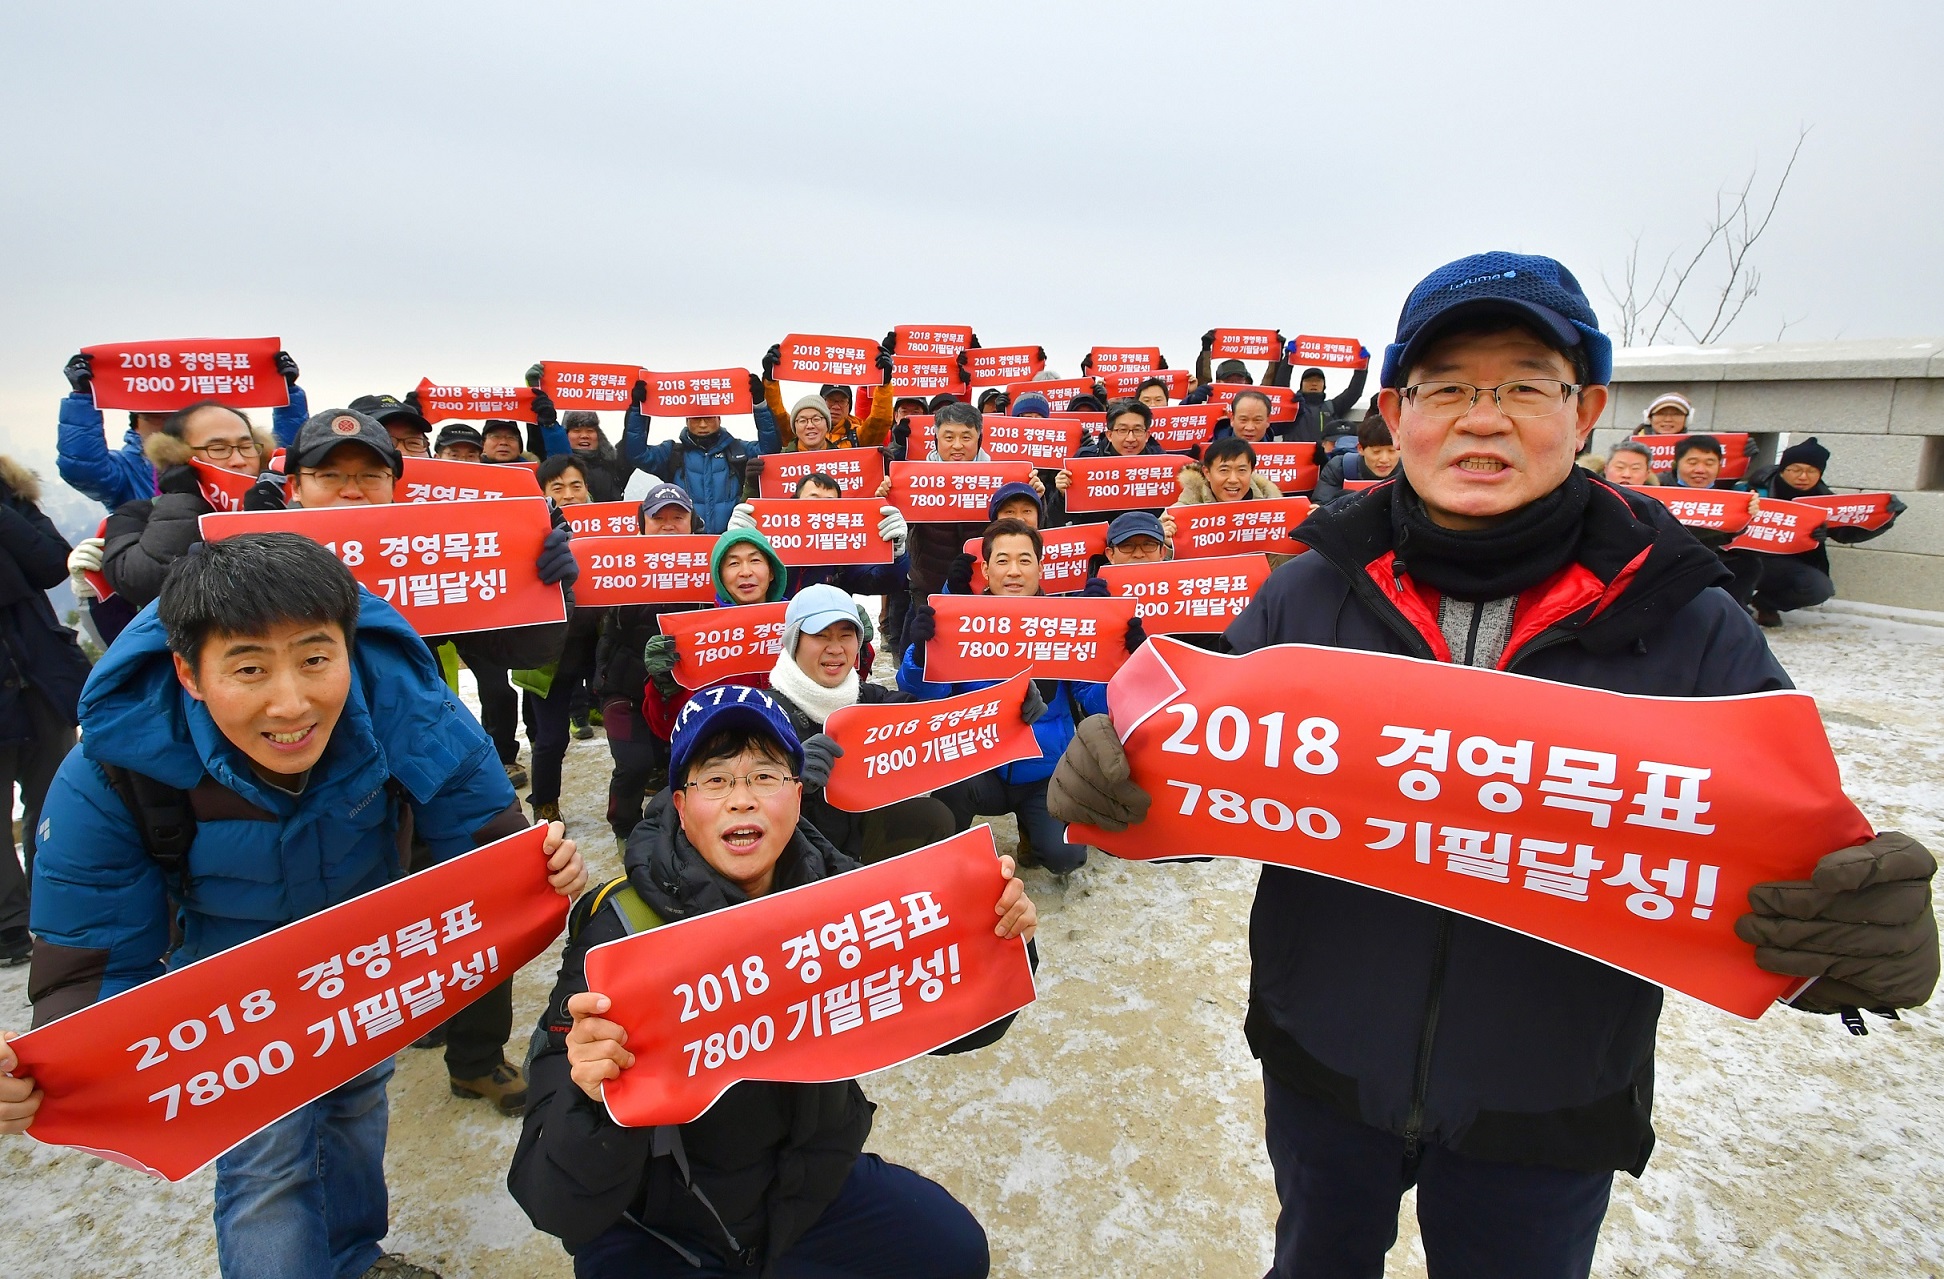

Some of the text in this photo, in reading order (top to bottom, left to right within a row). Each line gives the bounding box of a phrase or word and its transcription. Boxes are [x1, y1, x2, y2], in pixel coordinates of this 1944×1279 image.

[793, 345, 865, 360] 2018 경영목표
[1301, 342, 1352, 353] 2018 경영목표
[120, 353, 250, 371] 2018 경영목표
[975, 355, 1029, 365] 2018 경영목표
[1322, 353, 1354, 362] 기필달성!
[793, 360, 866, 375] 7800 기필달성!
[891, 364, 947, 374] 018 경영목표
[975, 366, 1030, 377] 7800 기필달성!
[123, 376, 254, 393] 7800 기필달성!
[558, 373, 626, 386] 2018 경영목표
[657, 379, 731, 390] 2018 경영목표
[891, 376, 948, 387] 800 기필달성!
[1118, 377, 1139, 385] 2018
[428, 387, 461, 397] 2018
[557, 388, 627, 401] 7800 기필달성!
[659, 393, 733, 405] 7800 기필달성!
[431, 401, 463, 410] 7800
[1171, 416, 1206, 428] 경영목표
[923, 426, 937, 437] 20
[991, 427, 1066, 442] 2018 경영목표
[1167, 429, 1206, 441] 기필달성!
[990, 443, 1067, 460] 7800 기필달성!
[780, 461, 861, 477] 2018 경영목표
[1088, 467, 1173, 480] 2018 경영목표
[781, 483, 797, 494] 78
[910, 475, 1003, 490] 2018 경영목표
[1088, 482, 1174, 496] 7800 기필달성!
[209, 484, 240, 512] 201
[910, 495, 945, 506] 7800
[1669, 501, 1724, 516] 경영목표
[608, 516, 638, 535] 경영
[762, 513, 864, 529] 2018 경영목표
[1191, 512, 1285, 529] 2018 경영목표
[806, 533, 866, 550] 기필달성!
[1193, 527, 1285, 547] 7800 기필달성!
[380, 532, 501, 567] 경영목표
[591, 553, 708, 569] 2018 경영목표
[1042, 558, 1087, 579] 필달성!
[375, 569, 506, 606] 기필달성!
[592, 573, 710, 589] 7800 기필달성!
[1123, 576, 1248, 596] 2018 경영목표
[1134, 597, 1251, 618] 800 기필달성!
[695, 622, 787, 645] 2018 경영
[959, 616, 1096, 637] 2018 경영목표
[695, 645, 742, 666] 7800
[959, 642, 1096, 661] 7800 기필달성!
[864, 699, 1001, 744] 2018 경영목표
[864, 722, 999, 778] 7800 기필달성!
[1161, 703, 1715, 836] 2018 경영목표
[1167, 780, 1720, 921] 7800 기필달성!
[673, 891, 949, 1024] 2018 경영목표
[126, 900, 484, 1072] 2018 경영목표
[682, 943, 962, 1077] 7800 기필달성!
[148, 946, 498, 1122] 7800 기필달성!
